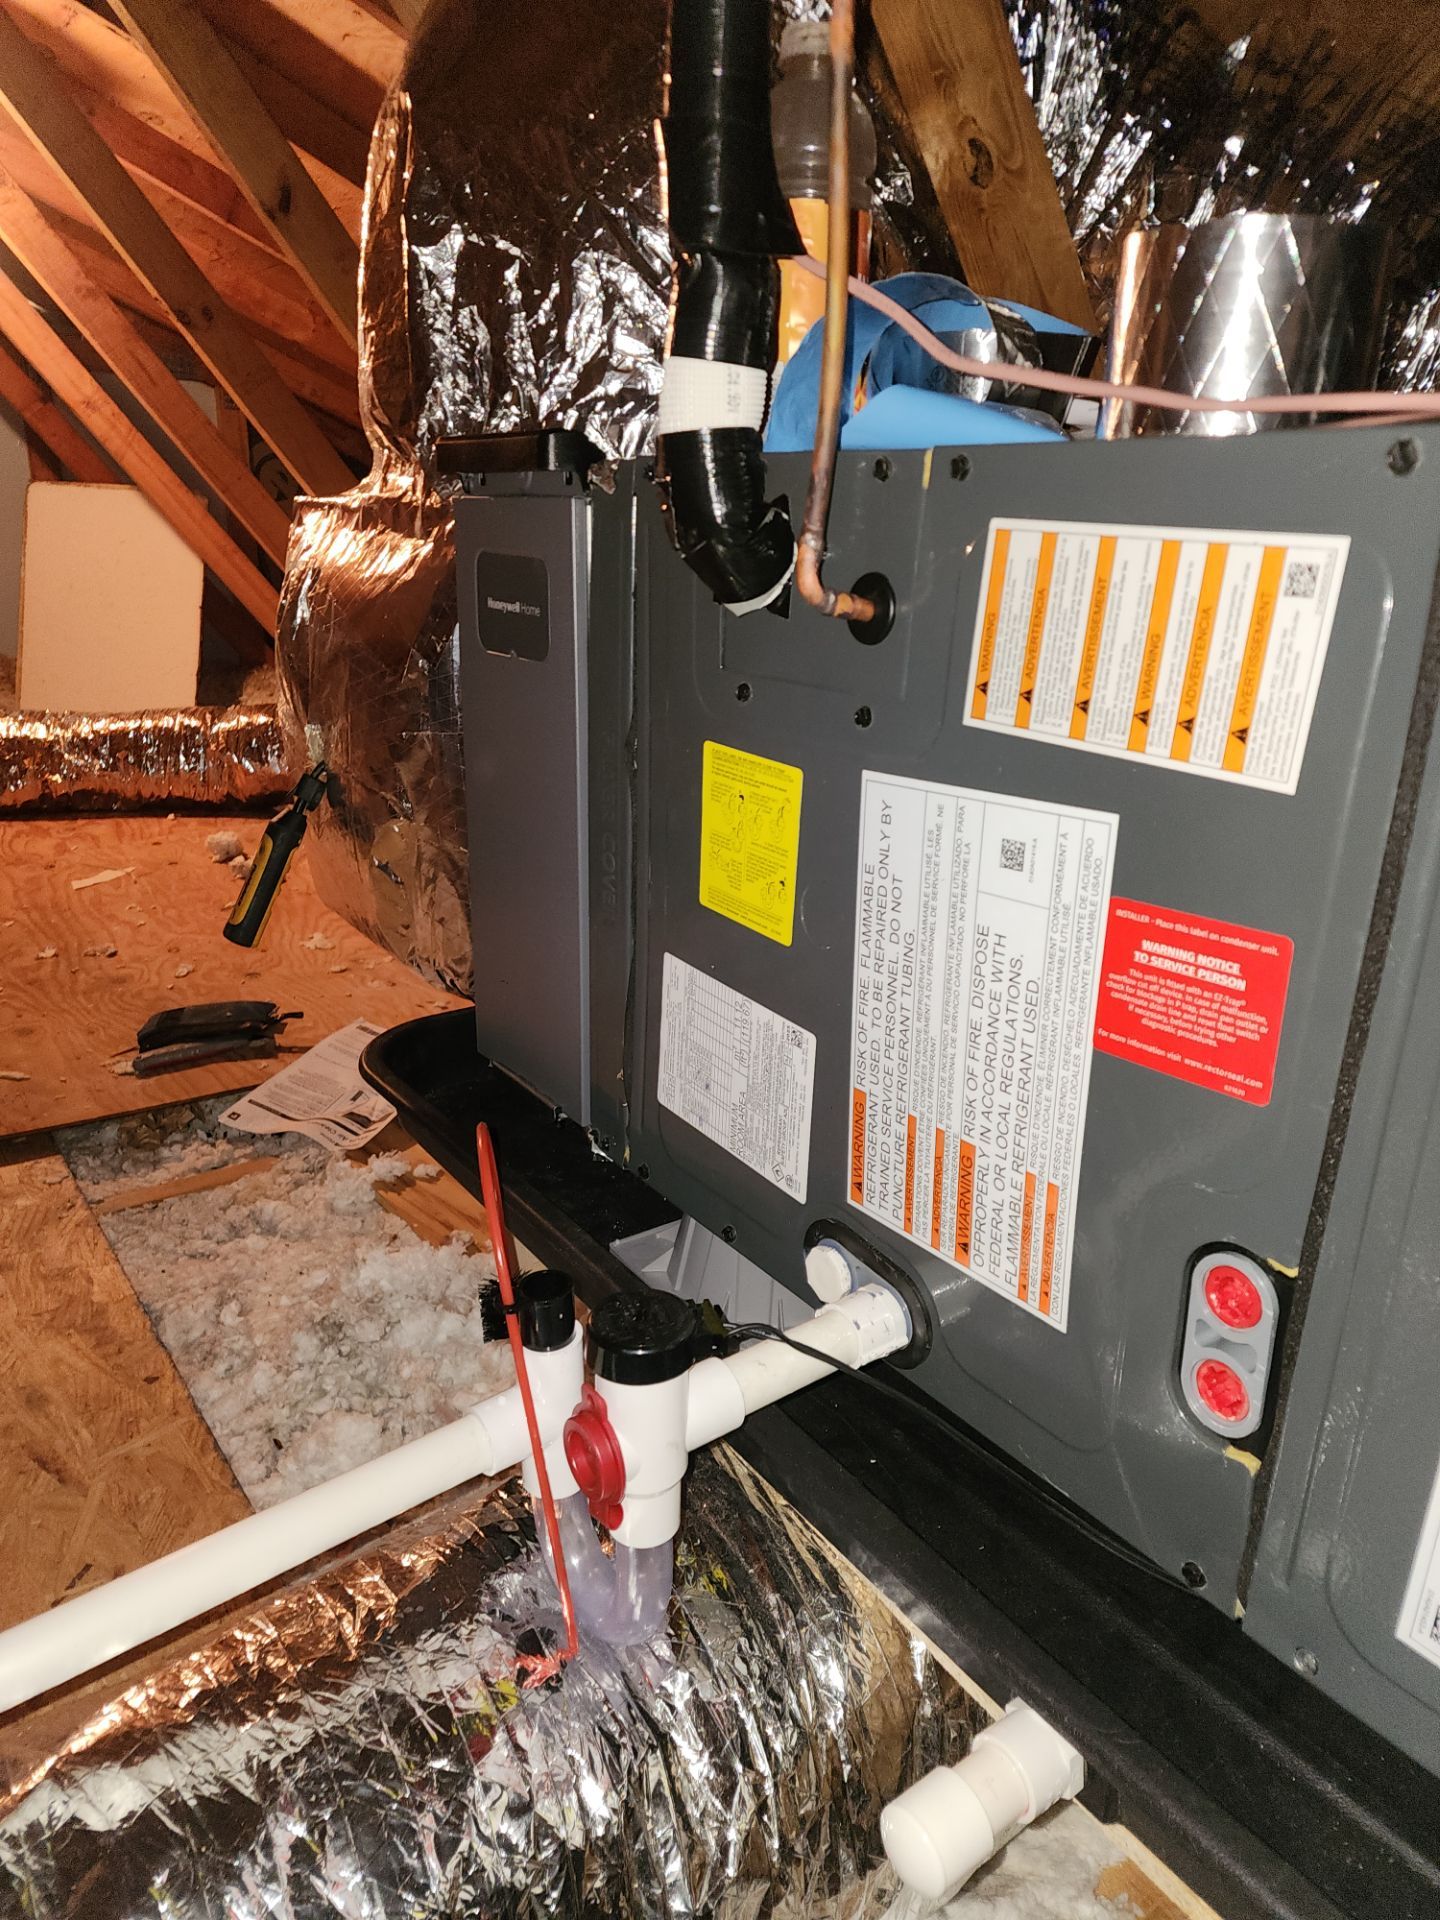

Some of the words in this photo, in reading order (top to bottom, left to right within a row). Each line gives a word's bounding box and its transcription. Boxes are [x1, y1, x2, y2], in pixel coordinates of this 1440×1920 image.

[487, 597, 520, 614] Honeywell
[521, 602, 541, 617] Home
[1024, 587, 1046, 679] ADVERTENCIA
[1081, 576, 1107, 689] AVERTISSEMENT
[980, 611, 996, 673] WARNING
[1140, 632, 1161, 701] WARNING
[1183, 606, 1213, 707] ADVERTENCIA
[1237, 590, 1272, 715] AVERTISSEMENT
[881, 799, 891, 825] BY
[956, 804, 965, 832] PARA
[878, 829, 890, 880] ONLY
[1080, 836, 1095, 893] ACUERDO
[860, 861, 874, 969] FLAMMABLE
[891, 873, 902, 913] NOT
[920, 892, 930, 956] INFLAMMABLE
[948, 890, 959, 951] INFLAMABLE
[1079, 893, 1088, 909] DE
[874, 884, 887, 975] REPAIRED
[889, 917, 900, 945] DO
[990, 932, 1007, 985] WITH
[1069, 911, 1086, 1007] ADECUADAMENTE
[1083, 898, 1098, 966] INFLAMABLE
[1115, 908, 1150, 924] INSTALLER
[1155, 918, 1174, 930] Place
[1174, 922, 1189, 933] this
[1189, 926, 1208, 938] label
[1209, 932, 1219, 941] on
[1220, 934, 1260, 951] condenser
[1260, 943, 1279, 956] unit.
[1140, 939, 1195, 962] WARNING
[1196, 953, 1240, 974] NOTICE
[873, 978, 883, 1002] BE
[901, 926, 915, 1000] TUBING.
[916, 957, 926, 1023] RÉFRIGÉRANT
[943, 953, 954, 1026] REFRIGERANTE
[971, 922, 990, 1010] DISPOSE
[1042, 934, 1057, 1022] CORRECTEMENT
[1052, 944, 1067, 1018] INFLAMMABLE
[1133, 950, 1149, 964] TO
[1150, 954, 1196, 977] SERVICE
[1196, 967, 1246, 990] PERSON
[858, 973, 870, 1017] FIRE.
[871, 1006, 881, 1029] TO
[884, 949, 899, 1060] PERSONNEL.
[999, 950, 1023, 1095] REGULATIONS.
[1022, 973, 1040, 1035] USED.
[1074, 967, 1090, 1050] REFRIGERANTE
[857, 1020, 867, 1045] OF
[869, 1034, 880, 1086] USED.
[968, 1013, 983, 1062] FIRE.
[980, 988, 1002, 1123] ACCORDANCE
[1036, 1022, 1049, 1071] ÉLIMINER
[1044, 1019, 1059, 1091] RÉFRIGÉRANT
[1061, 1007, 1076, 1072] DESÉCHELO
[1097, 1027, 1108, 1037] For
[1109, 1032, 1126, 1043] more
[1126, 1037, 1165, 1057] information
[1166, 1050, 1181, 1062] visit
[1183, 1055, 1263, 1089] www.rectorseal.com
[856, 1046, 866, 1087] RISK
[895, 1002, 911, 1126] REFRIGERANT
[911, 1078, 919, 1112] RISQUE
[940, 1074, 946, 1089] DE
[966, 1064, 978, 1092] OF
[729, 1101, 738, 1153] MINIMUM
[738, 1089, 746, 1120] AREA
[881, 1064, 894, 1138] SERVICE
[938, 1089, 946, 1124] RIESGO
[963, 1094, 976, 1139] RISK
[994, 1098, 1011, 1161] LOCAL
[1011, 1038, 1034, 1175] REFRIGERANT
[736, 1121, 744, 1158] ROOM
[852, 1099, 865, 1179] WARNING
[864, 1088, 879, 1205] REFRIGERANT
[979, 1124, 991, 1145] IN
[1029, 1128, 1040, 1168] RISQUE
[1040, 1134, 1048, 1151] OU
[1052, 1142, 1063, 1180] RIESGO
[1056, 1126, 1064, 1140] DE
[1063, 1111, 1075, 1172] FEDERALES
[878, 1136, 891, 1213] TRAINED
[891, 1128, 906, 1221] PUNCTURE
[905, 1134, 915, 1213] AVERTISSEMENT
[932, 1154, 943, 1224] ADVERTENCIA
[956, 1153, 974, 1241] WARNING
[992, 1162, 1006, 1193] OR
[1034, 1151, 1047, 1203] FÉDÉRALE
[970, 1145, 992, 1269] OFPROPERLY
[986, 1192, 1005, 1278] FEDERAL
[1003, 1176, 1025, 1288] FLAMMABLE
[1018, 1192, 1034, 1279] AVERTISSEMENT
[1053, 1171, 1070, 1273] REGLAMENTACIONES
[1041, 1211, 1056, 1286] ADVERTENCIA
[1029, 1288, 1037, 1302] LA
[1050, 1287, 1060, 1315] CON
[1052, 1272, 1061, 1288] LAS
